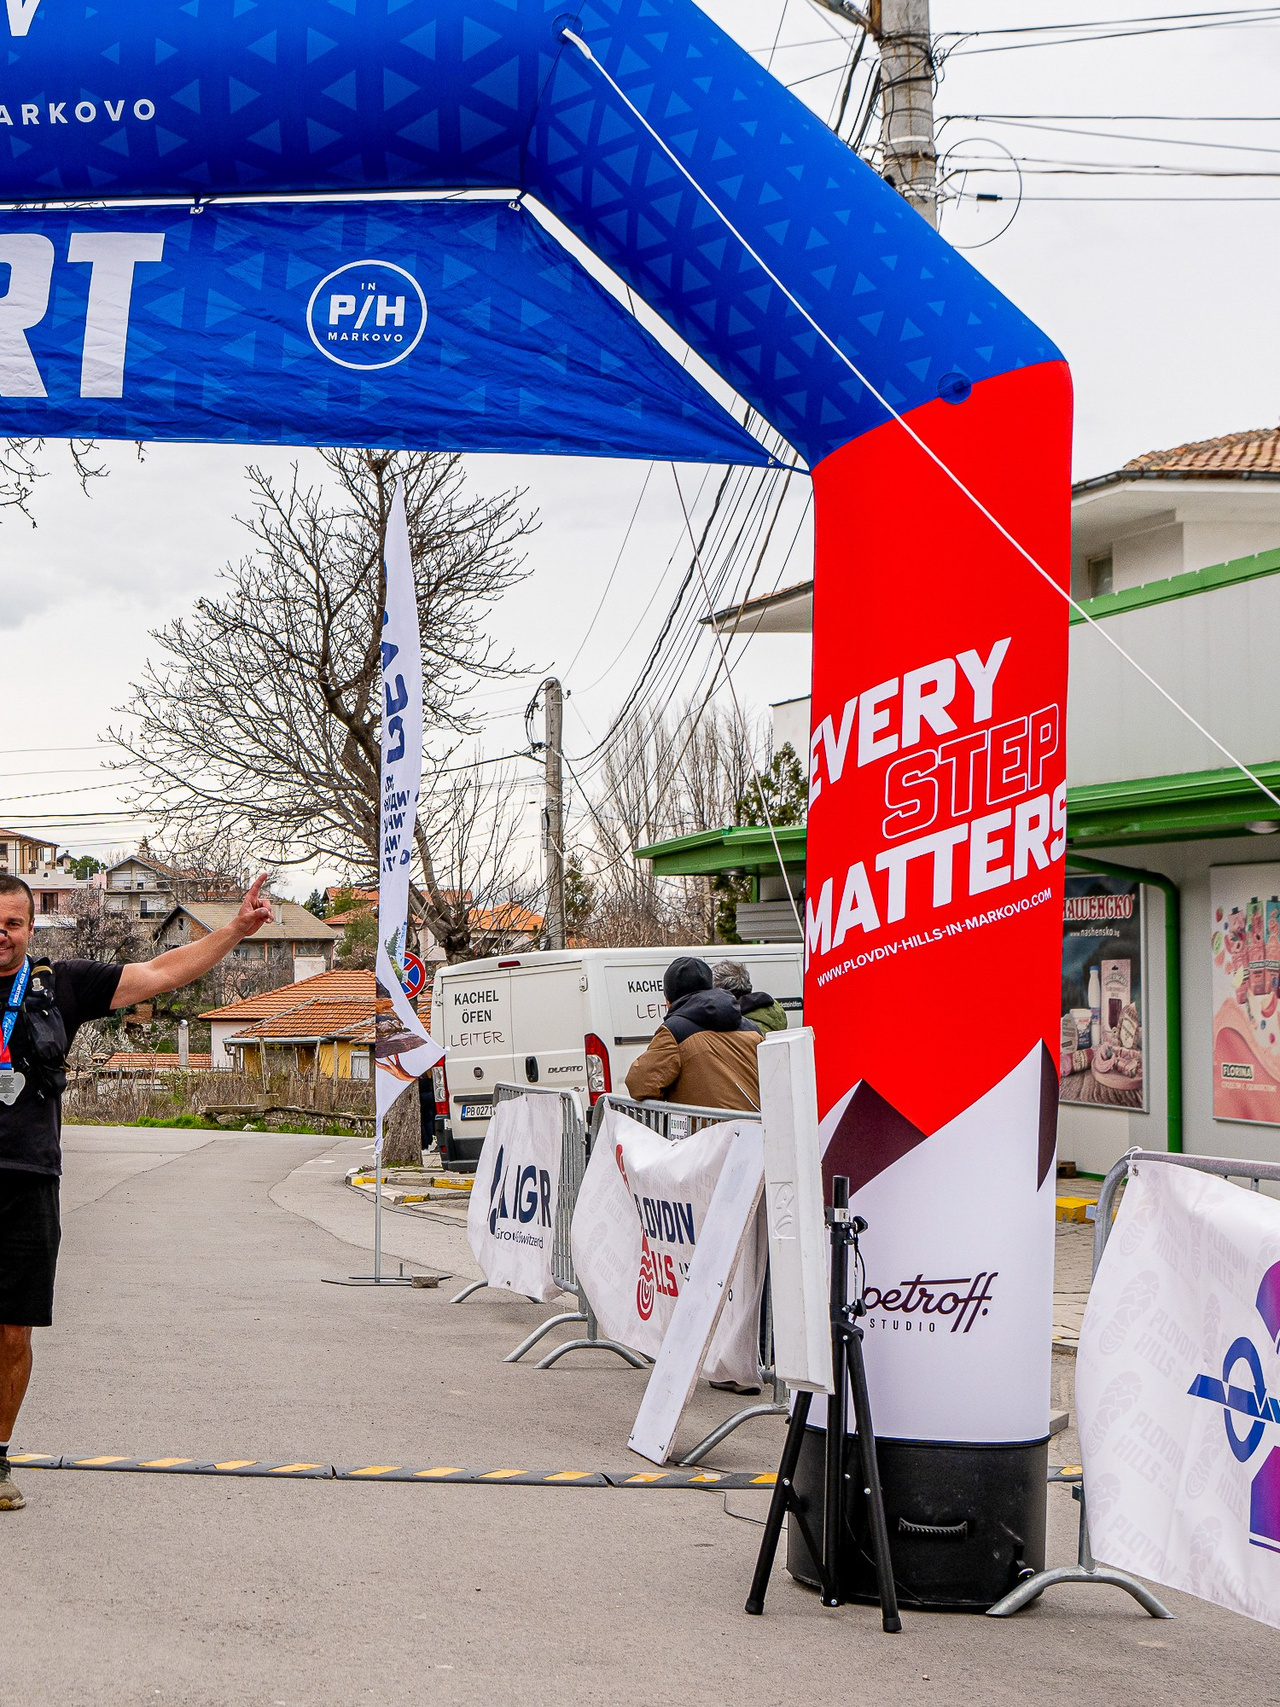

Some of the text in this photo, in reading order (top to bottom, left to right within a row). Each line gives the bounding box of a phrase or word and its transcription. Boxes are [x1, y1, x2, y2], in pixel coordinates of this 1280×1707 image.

[361, 282, 376, 291] IN
[328, 294, 406, 329] P/H
[327, 331, 403, 342] MARKOVO
[808, 636, 1012, 812] EVERY
[882, 703, 1059, 839] STEP
[805, 778, 1067, 975] MATTERS
[817, 887, 1053, 988] WWW.PLOVDIV-HILLS-IN-MARKOVO.COM
[627, 980, 664, 993] KACHE
[454, 990, 499, 1006] KACHEL
[462, 1009, 492, 1024] ÖFEN
[636, 1004, 667, 1019] LEIT
[450, 1031, 505, 1047] LEITER
[548, 1065, 583, 1074] DUCATO
[1222, 1063, 1253, 1080] FLORINA
[869, 1318, 936, 1333] STUDIO
